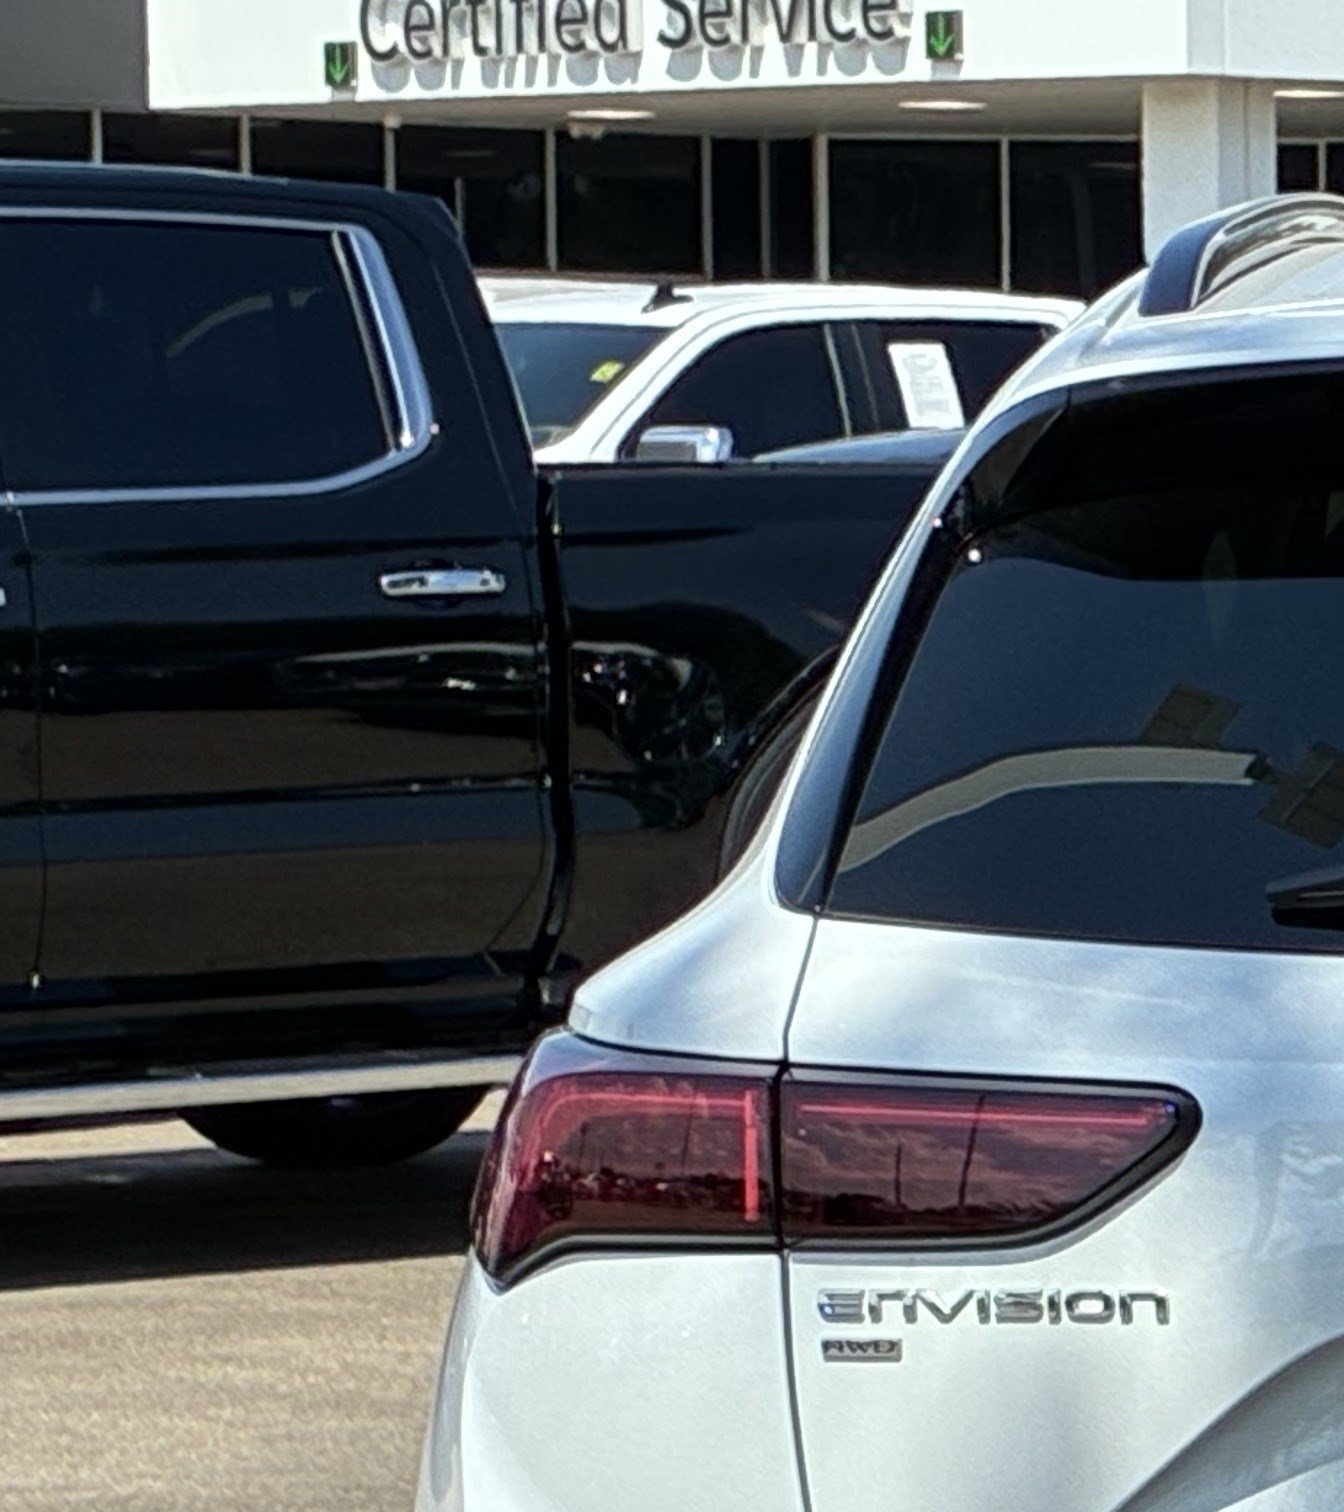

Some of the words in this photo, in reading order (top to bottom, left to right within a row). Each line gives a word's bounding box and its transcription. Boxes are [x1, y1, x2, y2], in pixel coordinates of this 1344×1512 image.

[360, 0, 630, 61] Certified
[657, 0, 895, 48] Service
[817, 1288, 1171, 1325] ENVISION
[821, 1339, 898, 1354] AWD
